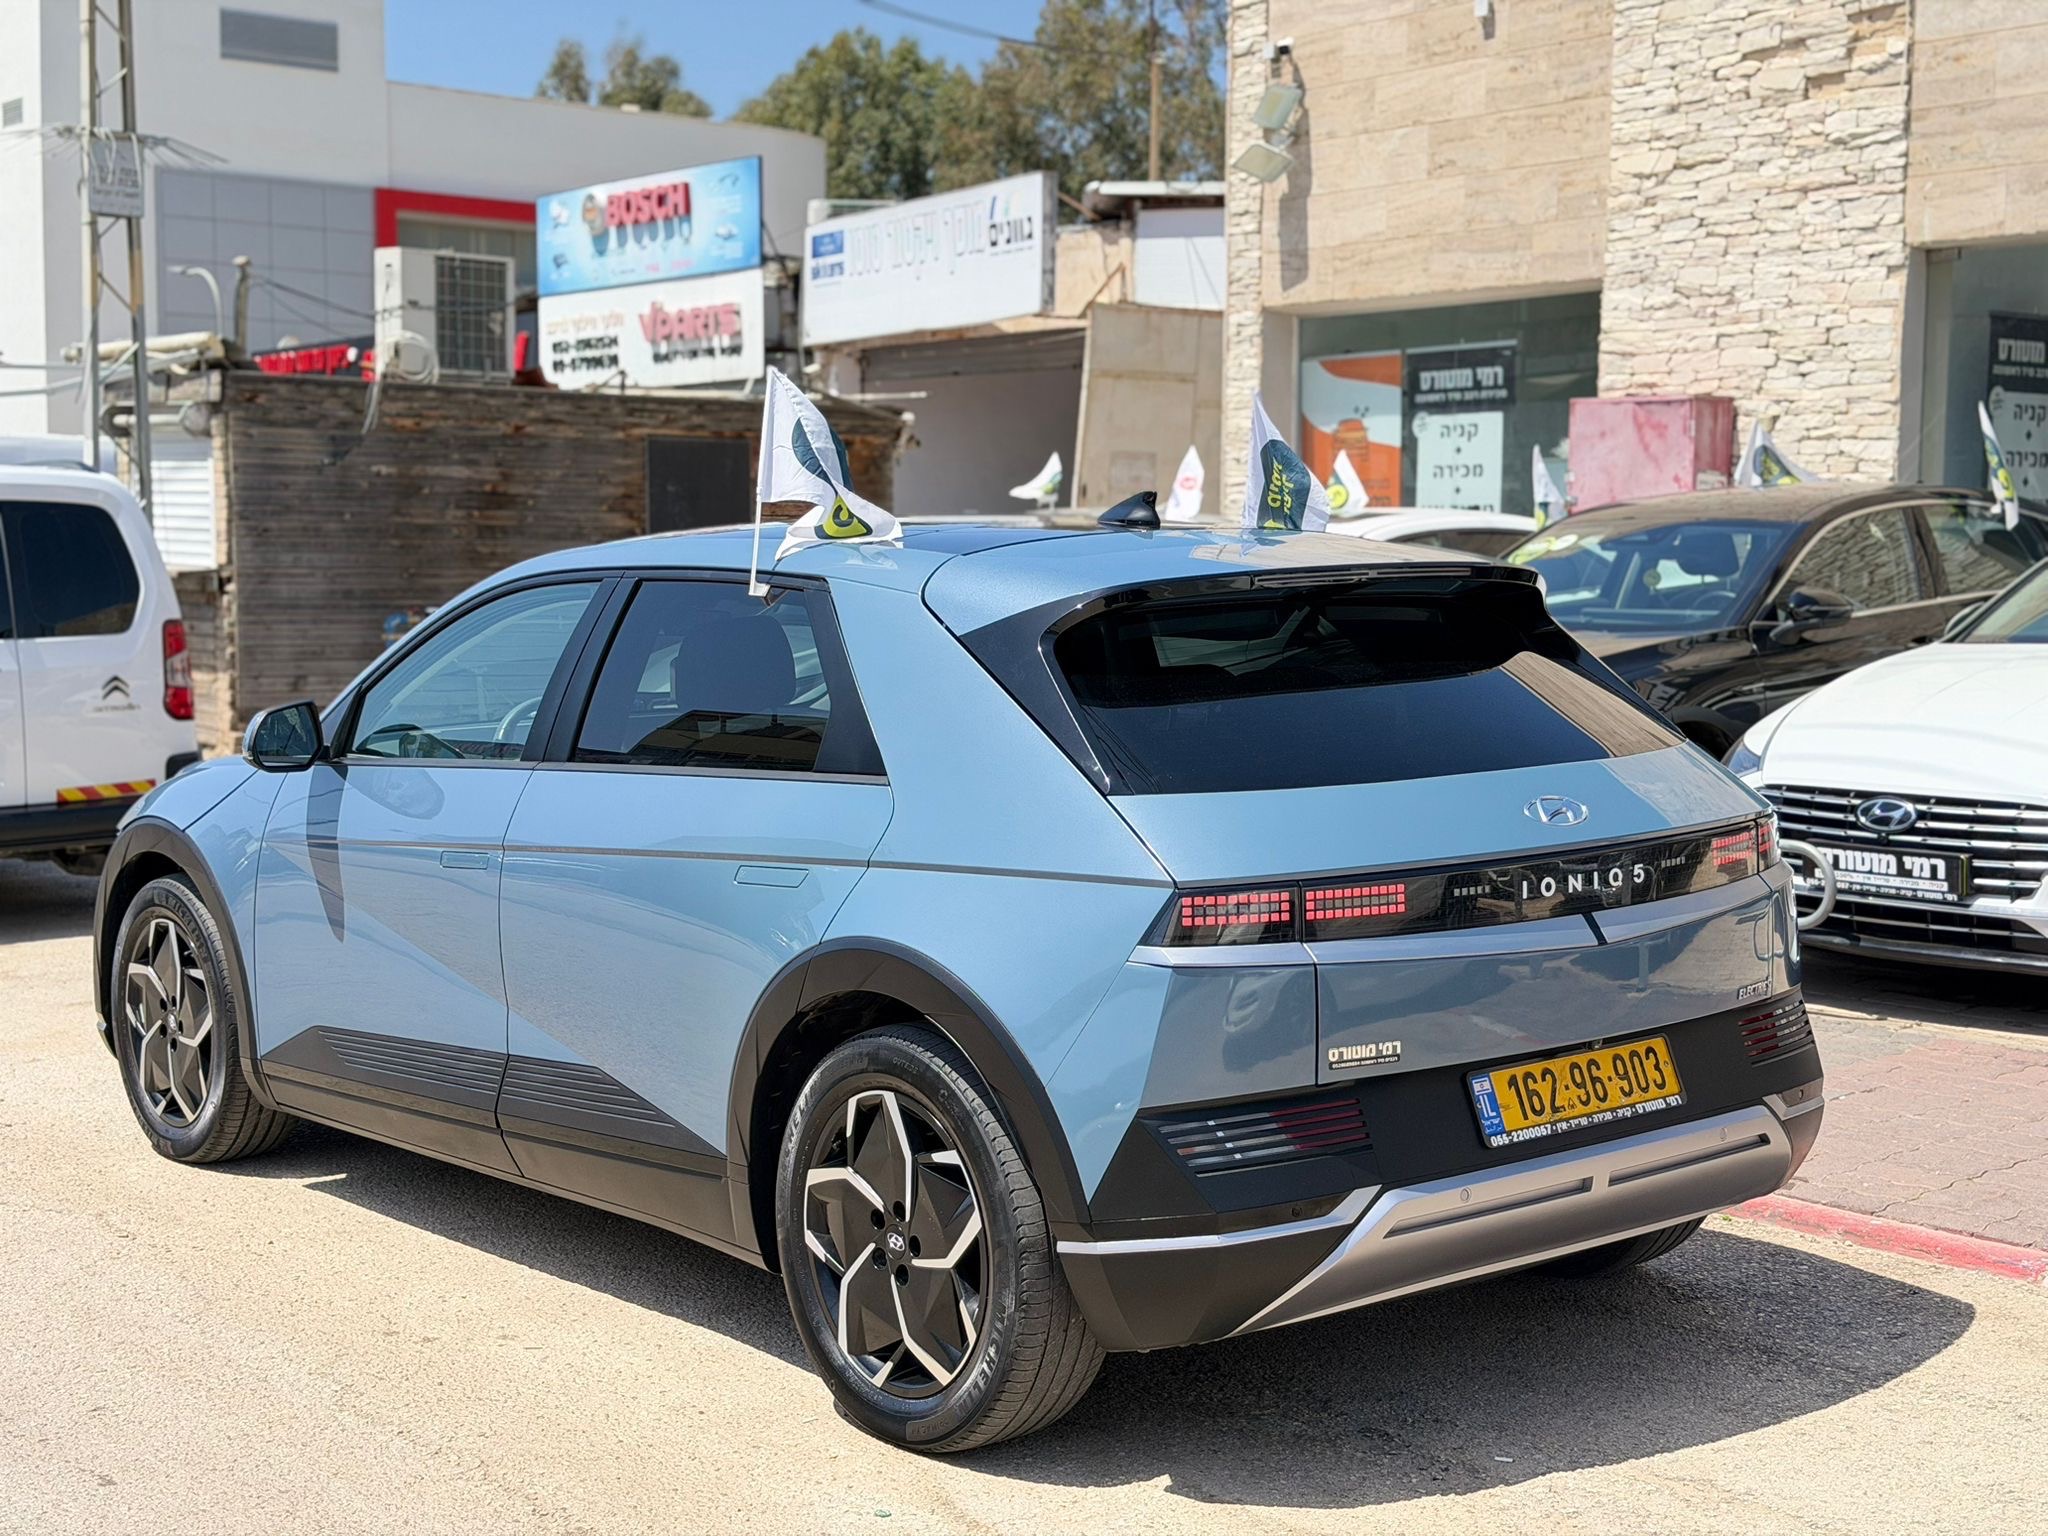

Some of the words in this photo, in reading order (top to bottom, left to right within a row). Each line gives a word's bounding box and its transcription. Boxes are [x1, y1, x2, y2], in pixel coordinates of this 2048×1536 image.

[606, 182, 691, 228] BOSCH
[1419, 368, 1474, 391] מוטורס
[1476, 365, 1504, 387] רמי
[2013, 403, 2046, 427] קניה
[1439, 423, 1479, 441] קניה
[2005, 451, 2048, 468] מכירה
[1432, 464, 1484, 479] מכירה
[1902, 855, 1946, 880] רמי
[1522, 867, 1623, 900] IONIQ
[1632, 863, 1645, 884] 5
[1328, 1043, 1376, 1062] מוטורס
[1379, 1040, 1401, 1055] רמי
[1479, 1094, 1497, 1118] IL
[1635, 1099, 1666, 1114] מוטורס
[1666, 1095, 1683, 1107] רמי
[1592, 1111, 1613, 1124] מכירה
[1616, 1105, 1632, 1118] קניה
[1490, 1123, 1552, 1147] 055-2200057
